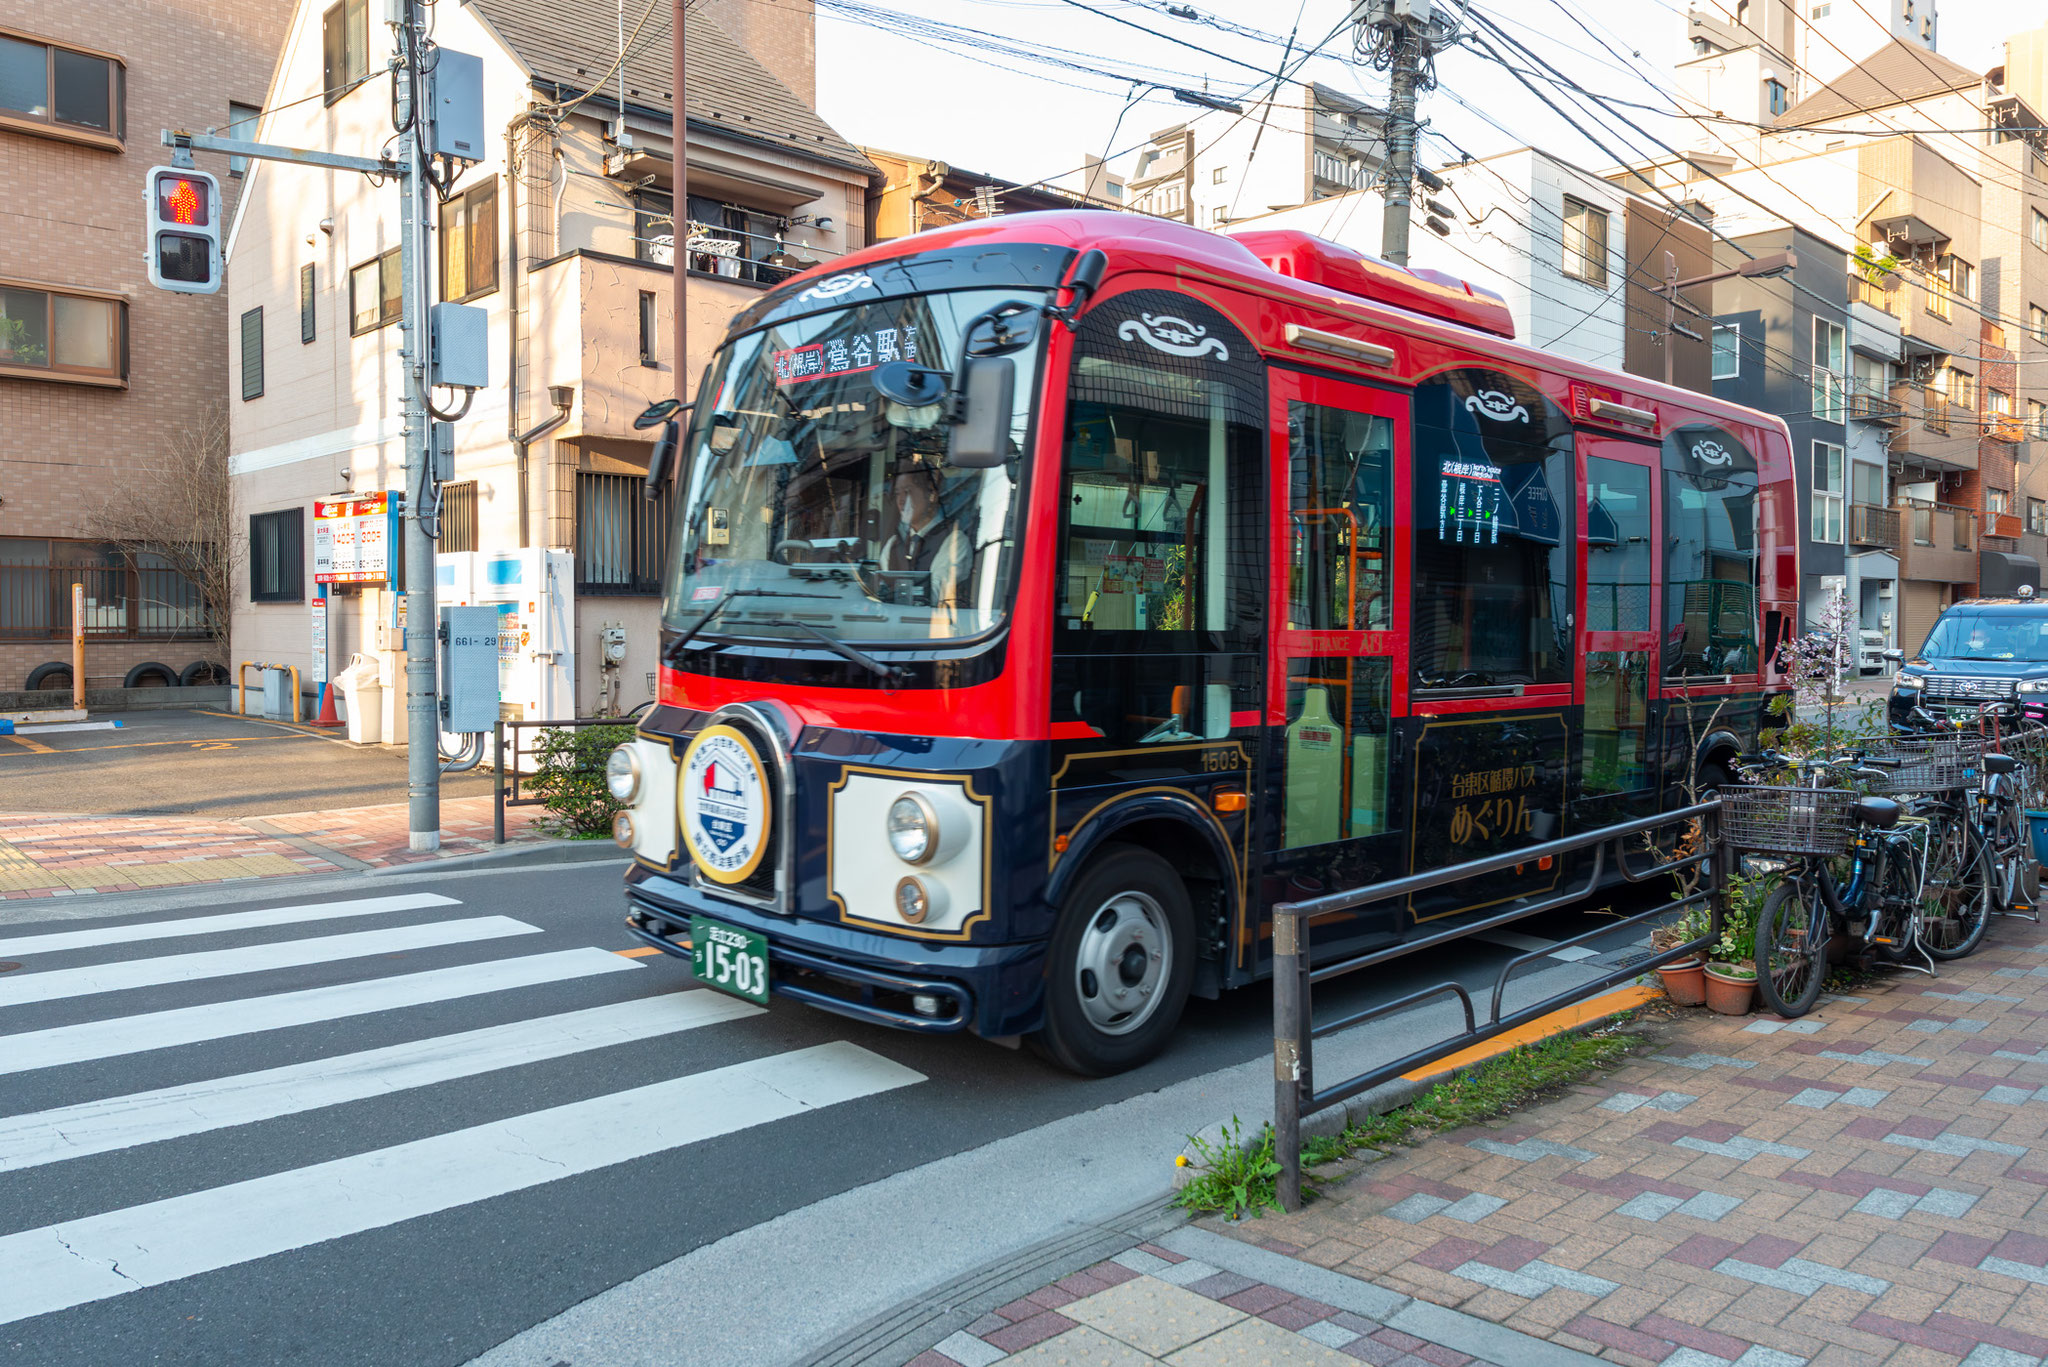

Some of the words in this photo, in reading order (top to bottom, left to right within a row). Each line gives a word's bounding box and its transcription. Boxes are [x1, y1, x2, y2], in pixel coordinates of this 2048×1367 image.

[484, 637, 497, 647] 29
[1201, 751, 1239, 772] 1503
[1452, 765, 1536, 799] 台東区循環バス
[1450, 794, 1535, 846] めぐりん
